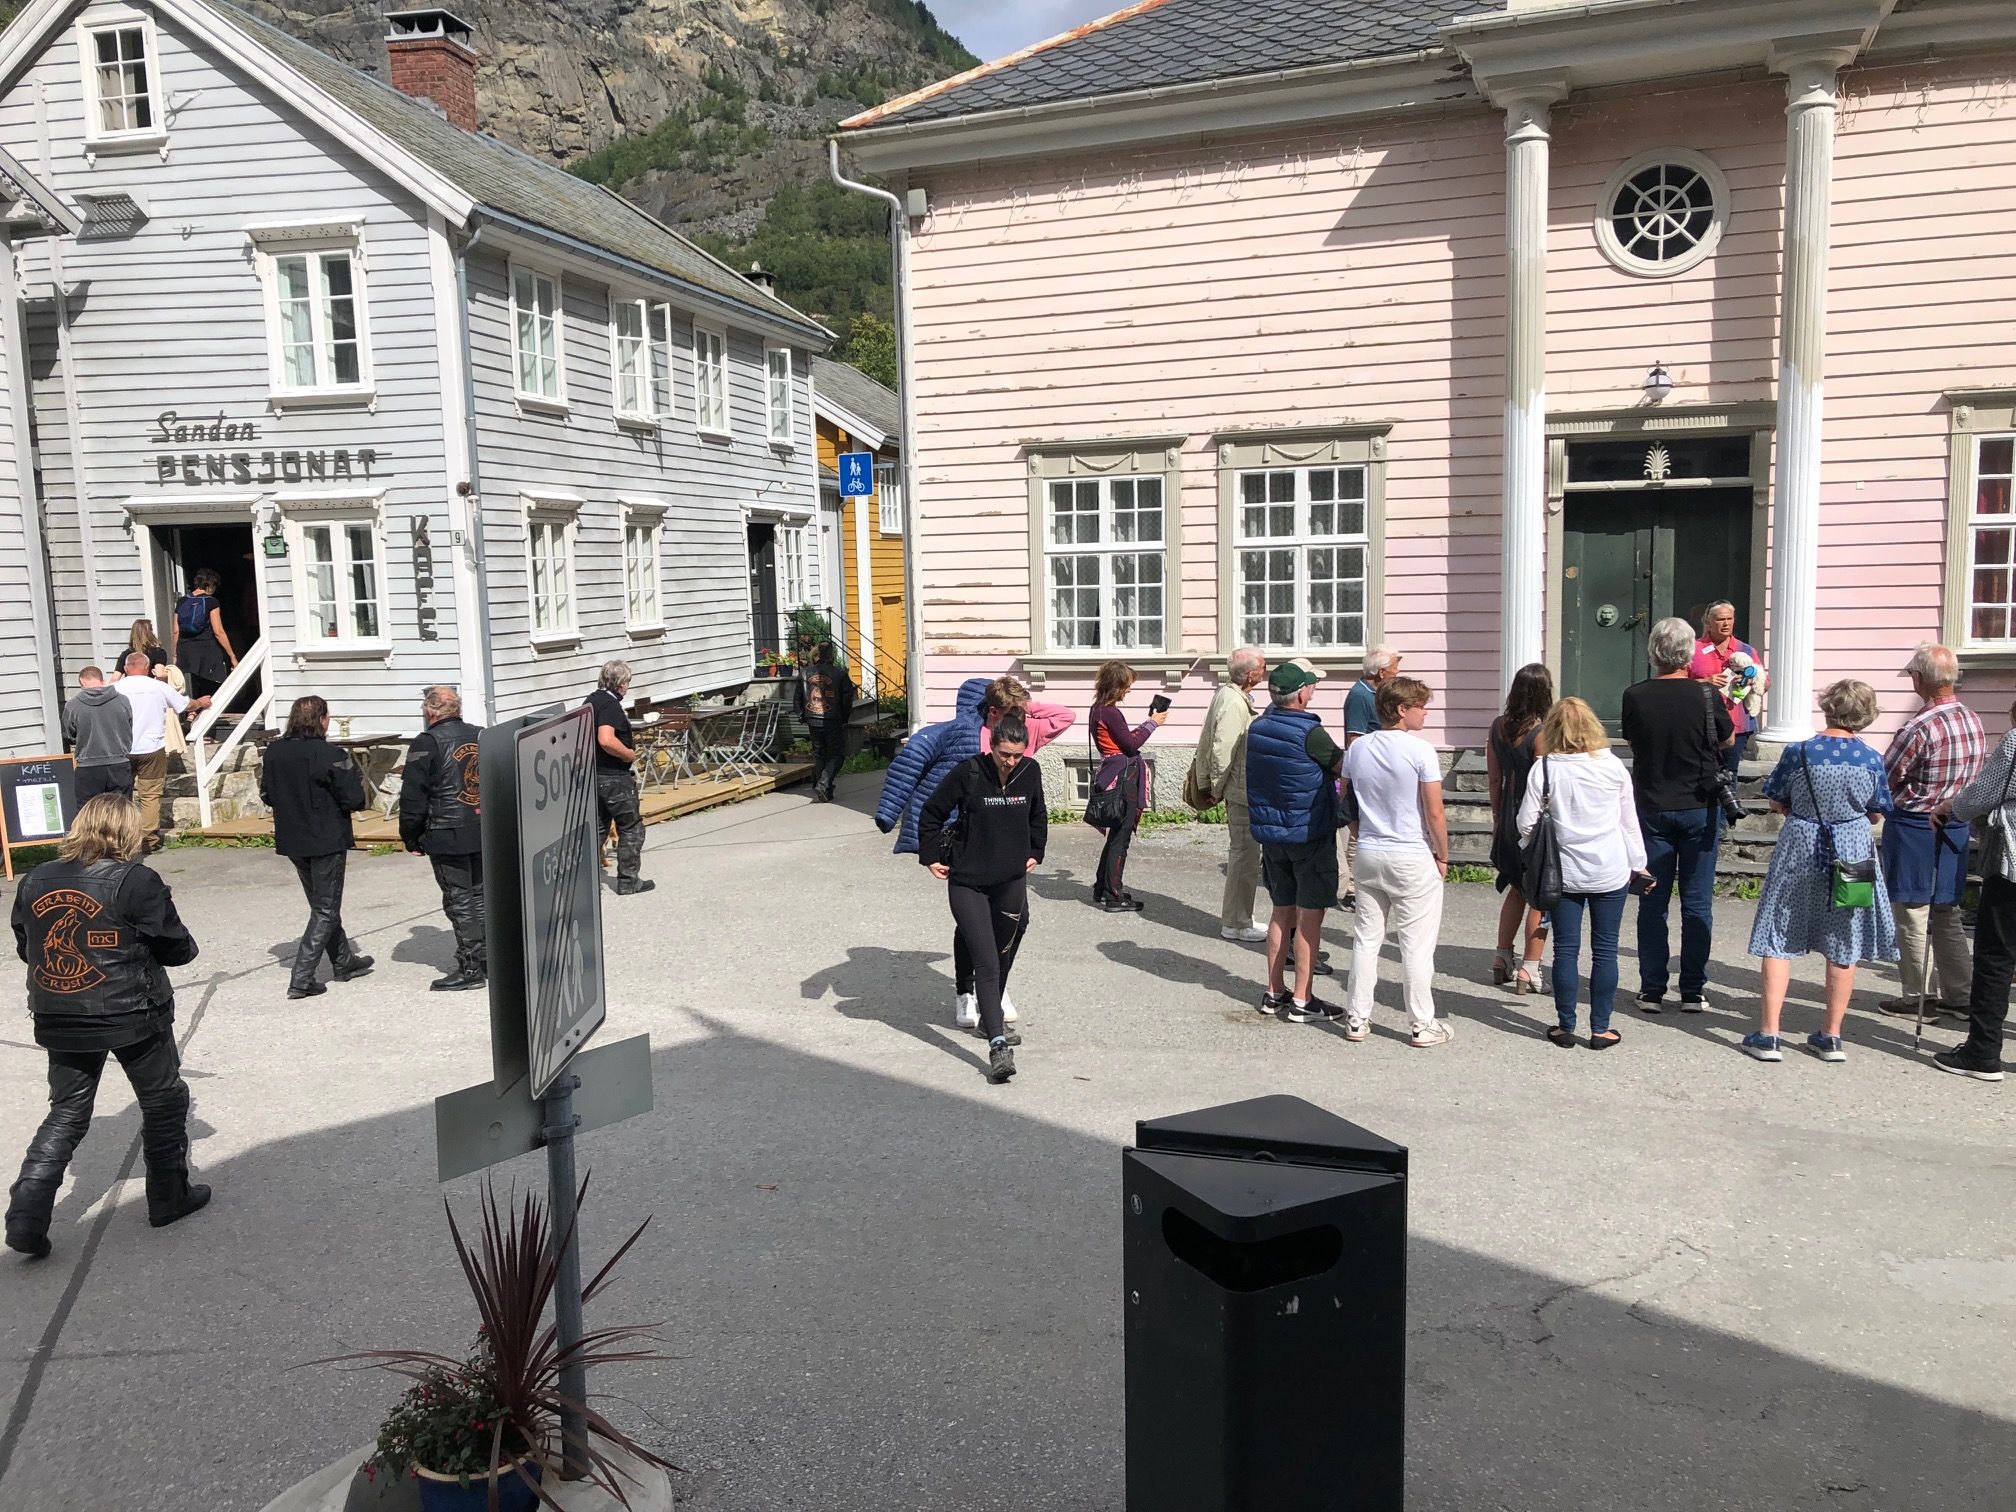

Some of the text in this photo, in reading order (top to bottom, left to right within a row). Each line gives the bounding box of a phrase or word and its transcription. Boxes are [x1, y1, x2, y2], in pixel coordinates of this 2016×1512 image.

[152, 409, 255, 443] Sanden
[156, 449, 377, 487] PENSJONAT
[455, 531, 461, 544] 9
[21, 761, 52, 775] KAFÉ
[534, 749, 585, 811] Sone
